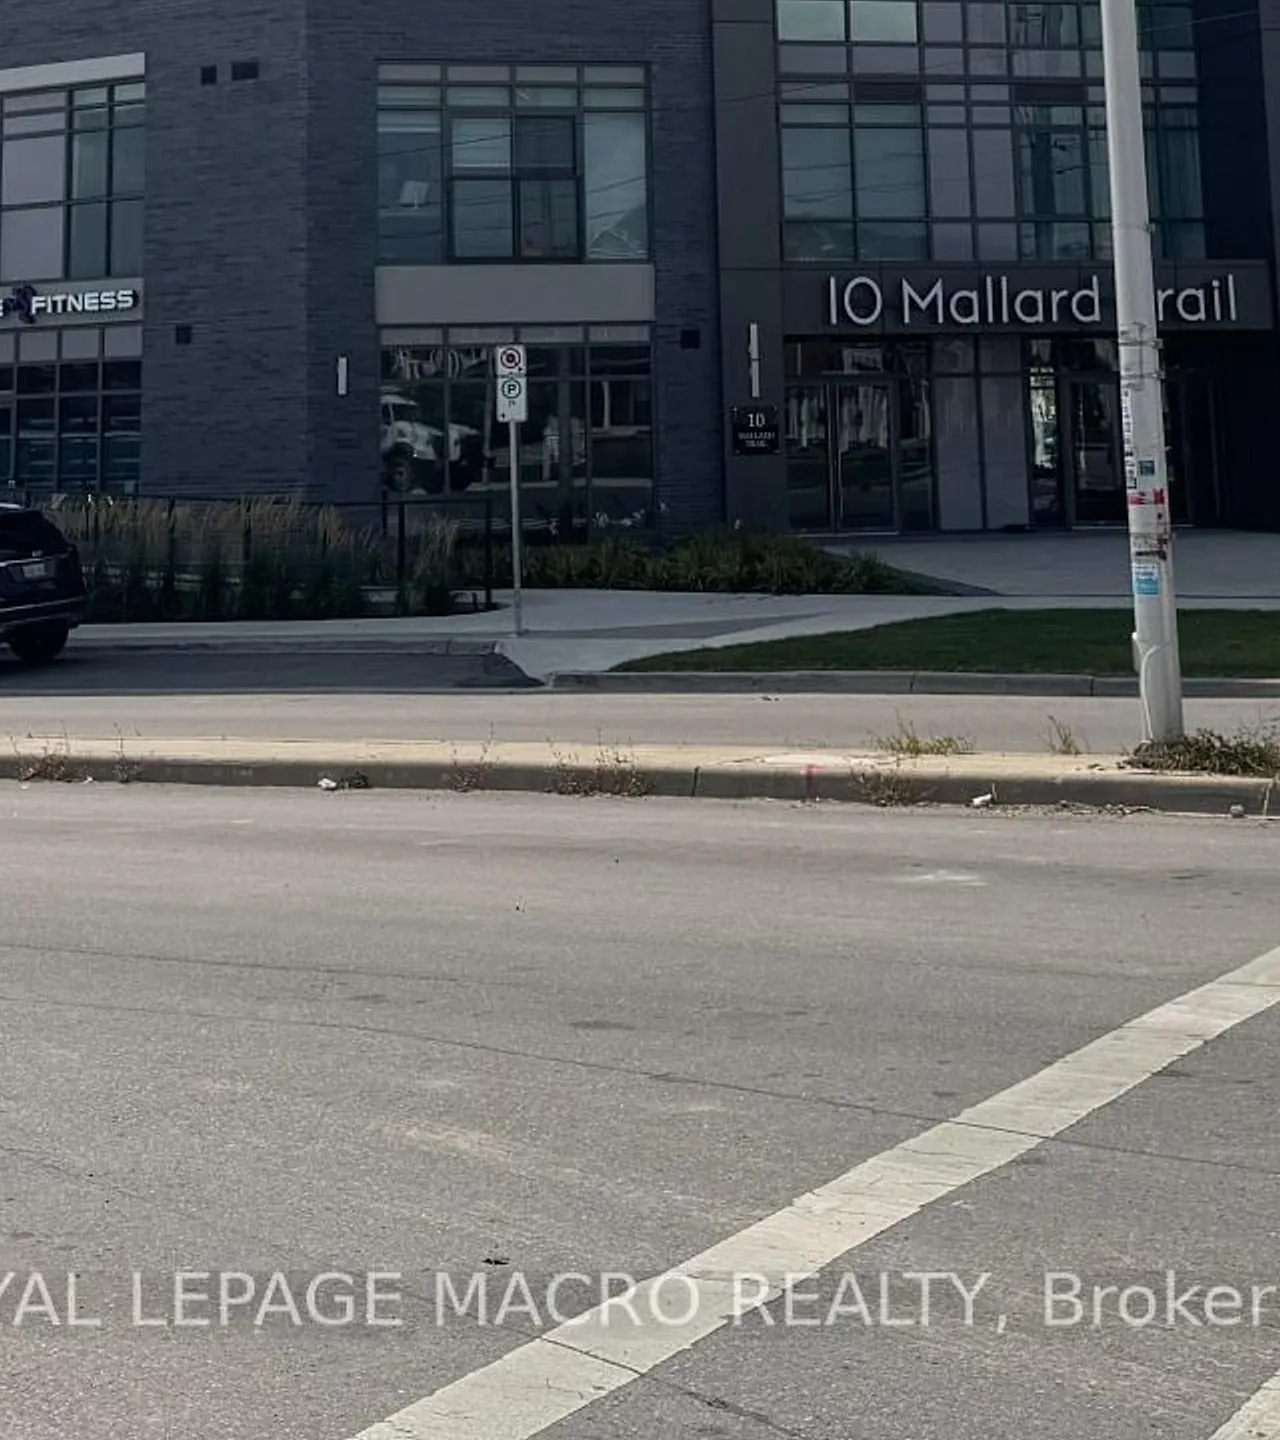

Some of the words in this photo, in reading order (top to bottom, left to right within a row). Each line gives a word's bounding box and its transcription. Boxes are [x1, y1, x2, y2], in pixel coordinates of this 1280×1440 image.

[31, 289, 134, 315] FITNESS
[901, 274, 1101, 325] Mallard
[1156, 273, 1237, 322] rail
[747, 412, 766, 428] 10
